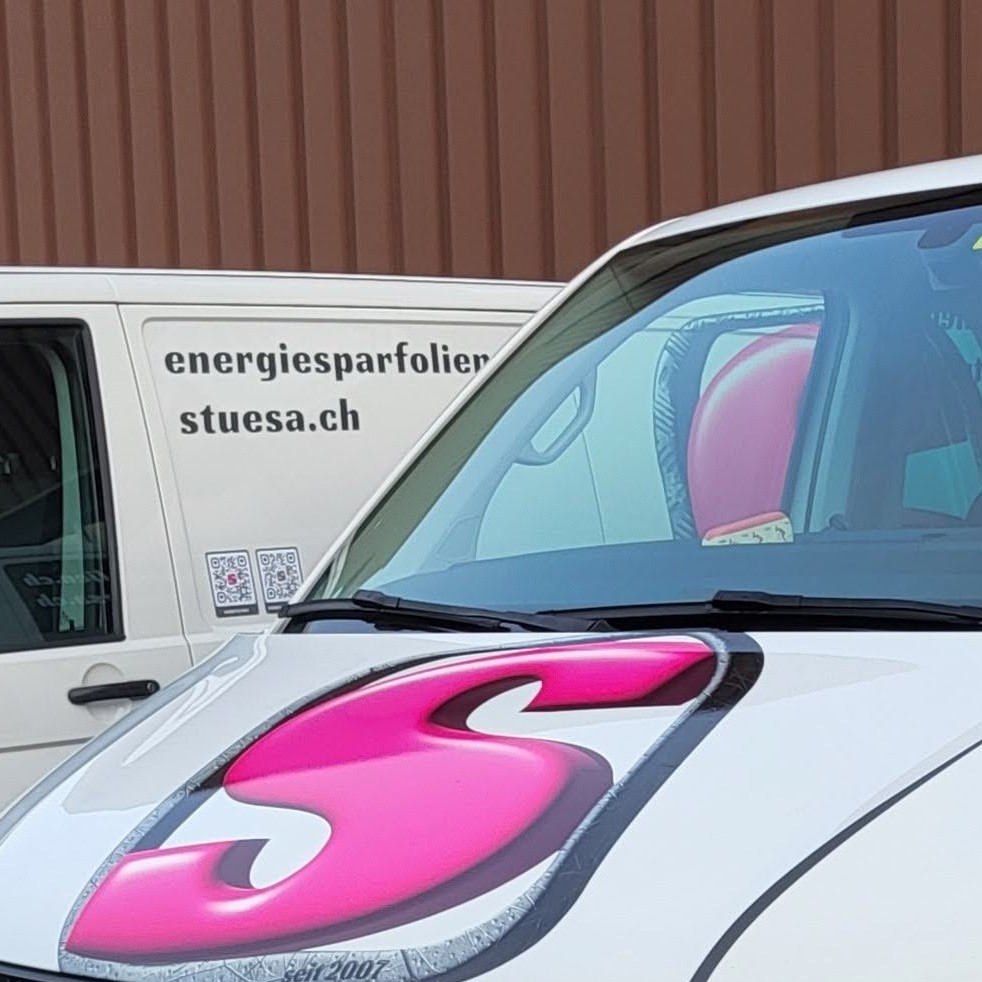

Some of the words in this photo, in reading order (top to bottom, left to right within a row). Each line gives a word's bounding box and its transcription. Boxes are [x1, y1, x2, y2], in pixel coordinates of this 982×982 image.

[180, 398, 361, 435] stuesa.ch
[283, 962, 325, 982] seit
[324, 959, 391, 981] 2007
